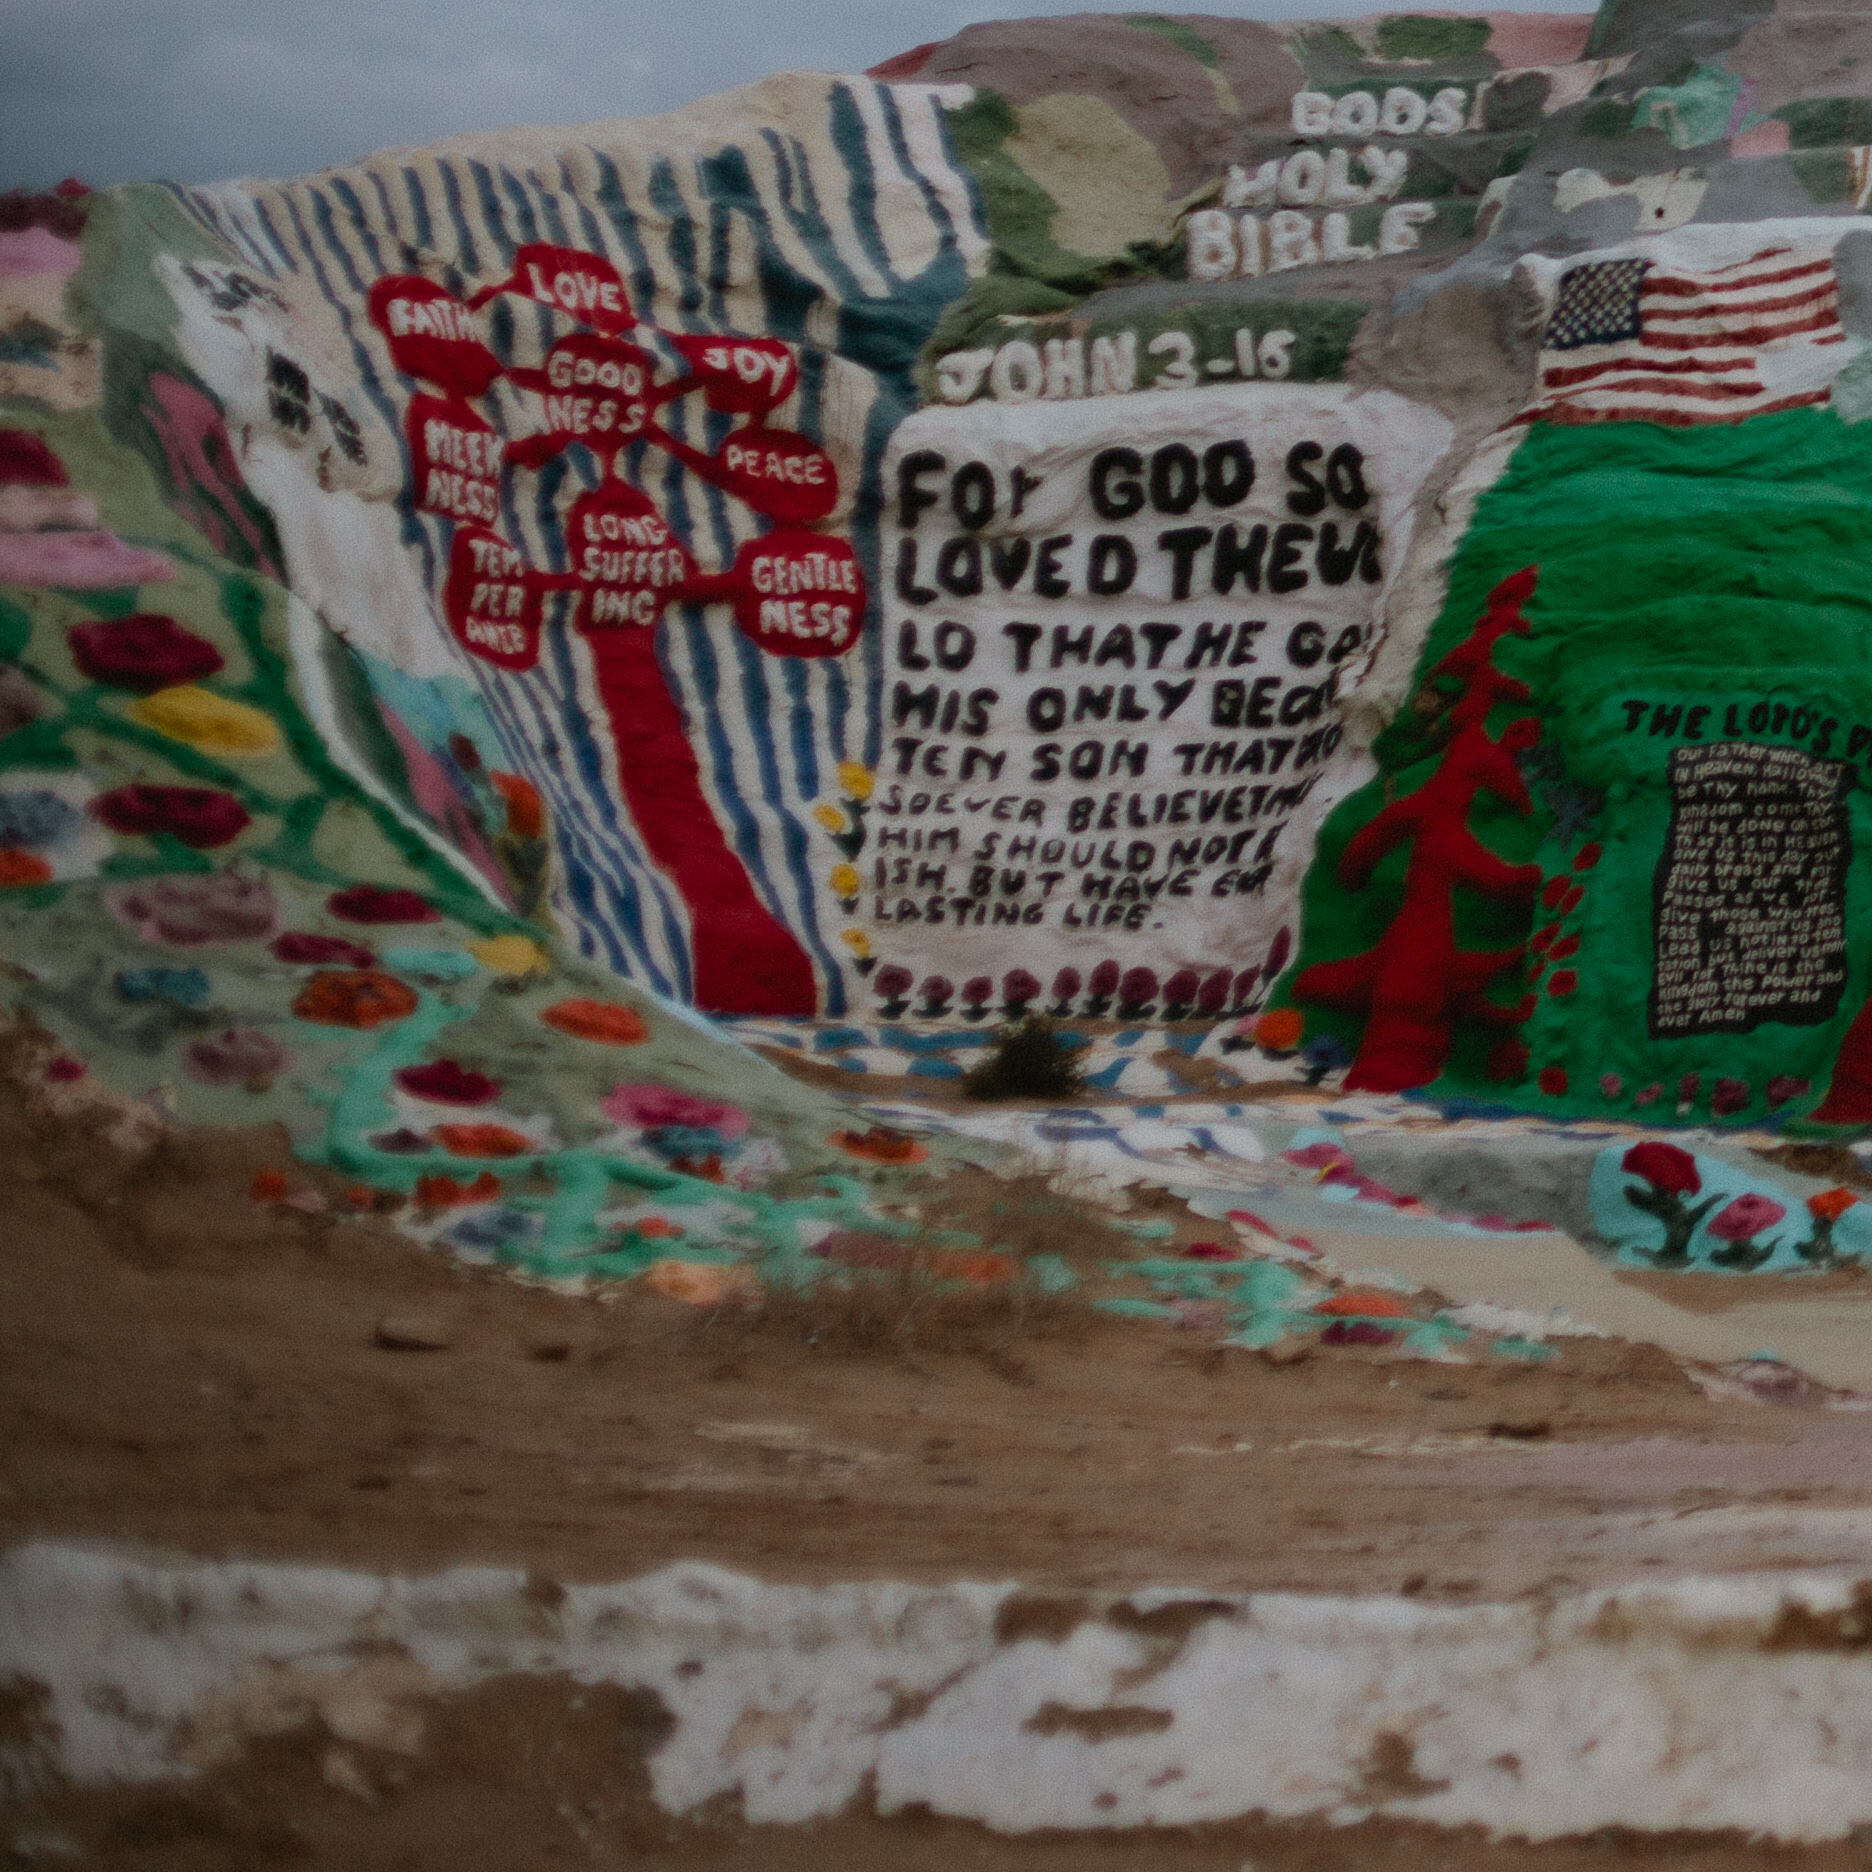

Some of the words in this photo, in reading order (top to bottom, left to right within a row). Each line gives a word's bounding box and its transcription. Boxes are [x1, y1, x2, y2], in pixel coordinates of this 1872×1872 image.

[1293, 87, 1467, 136] GODS
[1222, 145, 1408, 207] HOLY
[1188, 203, 1436, 278] BIBLE
[526, 262, 622, 312] LOVE
[387, 298, 478, 342] FAITH
[548, 350, 642, 396] GOOD
[703, 346, 790, 397] JOY
[936, 332, 1135, 404] JOHN
[547, 394, 646, 434] NESS
[726, 444, 826, 485] PEACE
[1089, 439, 1255, 521] GOD
[1286, 442, 1370, 516] SO
[425, 468, 496, 521] NESS
[583, 513, 667, 545] LONG
[468, 538, 525, 577] TEM
[579, 545, 685, 587] SUFFER
[751, 553, 857, 595] GENTLE
[900, 532, 1136, 605] LOVED
[471, 583, 525, 617] PER
[759, 600, 850, 646] NESS
[1001, 621, 1182, 673] THAT
[1184, 621, 1268, 670] HE
[891, 680, 999, 737] HIS
[1026, 678, 1196, 733] ONLY
[1622, 699, 1710, 740] THE
[893, 736, 1006, 783] TEN
[1030, 739, 1148, 781] SON
[1173, 736, 1296, 777] THAT
[878, 783, 1046, 828] SOEVER
[878, 826, 960, 854] HIM
[974, 831, 1156, 873] SHOULD
[1167, 828, 1258, 868] NOT
[969, 864, 1066, 898] BUT
[1080, 869, 1202, 902] HAVE
[874, 894, 1044, 928] LASTING
